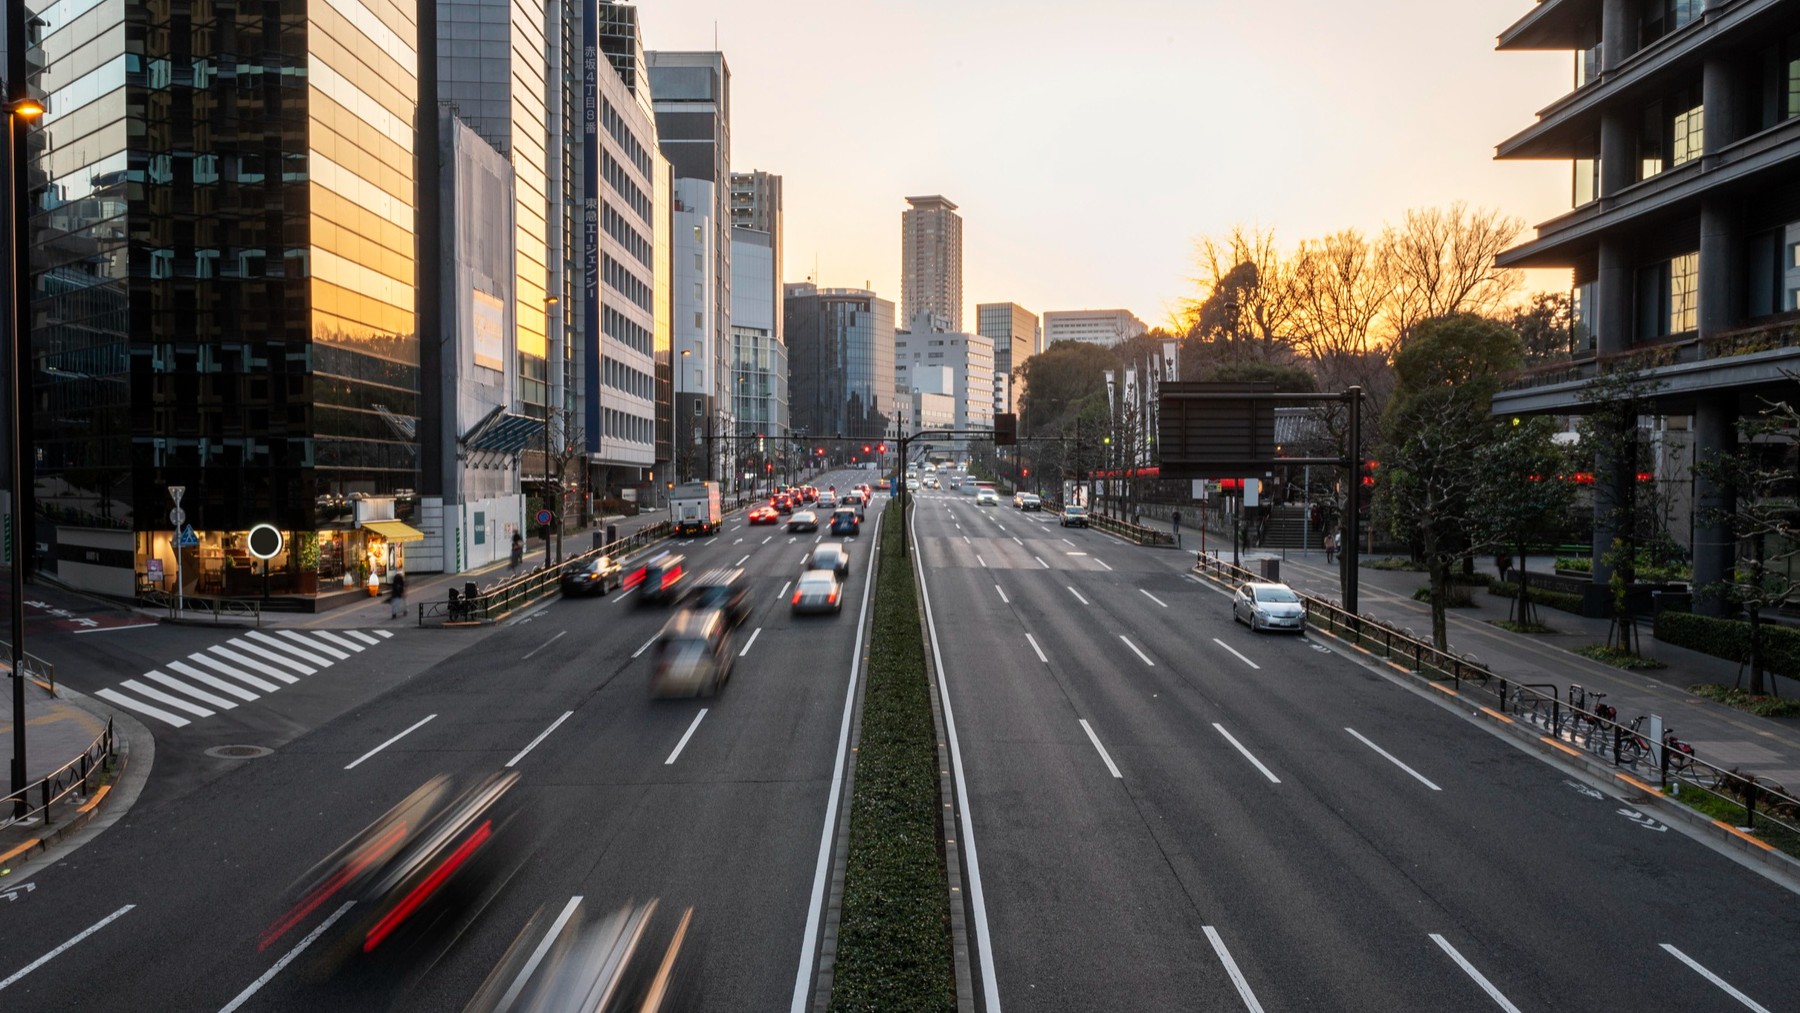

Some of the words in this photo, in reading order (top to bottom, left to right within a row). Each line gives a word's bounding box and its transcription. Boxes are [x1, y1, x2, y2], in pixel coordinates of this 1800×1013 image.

[585, 46, 596, 133] 赤坂4丁目8番
[585, 198, 597, 298] 東急エージェンシー
